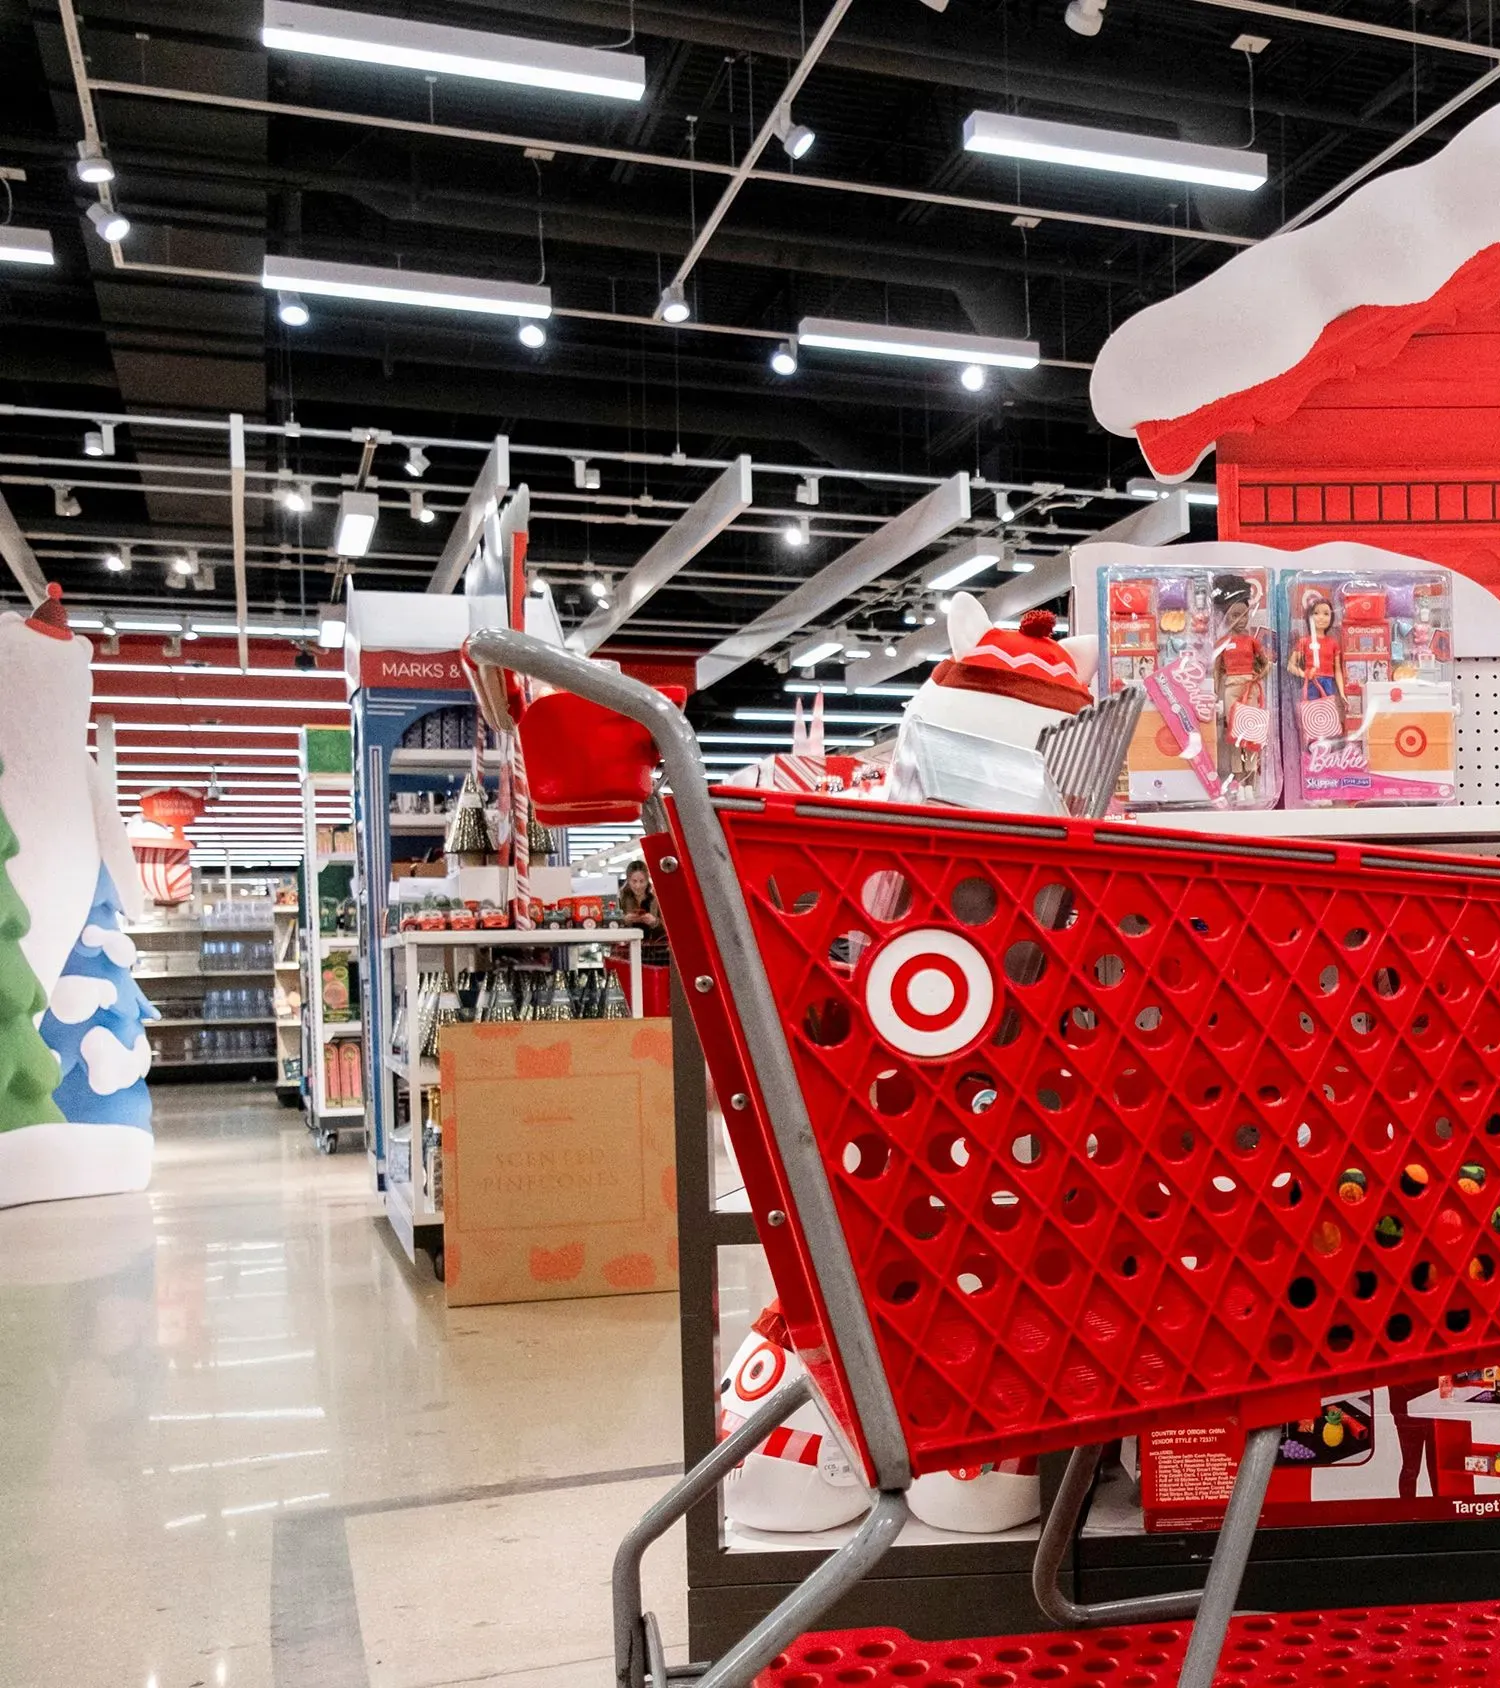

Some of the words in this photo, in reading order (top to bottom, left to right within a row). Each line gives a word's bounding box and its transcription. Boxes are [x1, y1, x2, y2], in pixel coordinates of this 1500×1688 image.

[382, 662, 444, 679] MARKS
[449, 663, 461, 679] &
[1172, 661, 1218, 722] Barbie
[1309, 740, 1369, 772] Barbie
[1305, 777, 1339, 789] Skipper
[1452, 1500, 1500, 1515] Target
